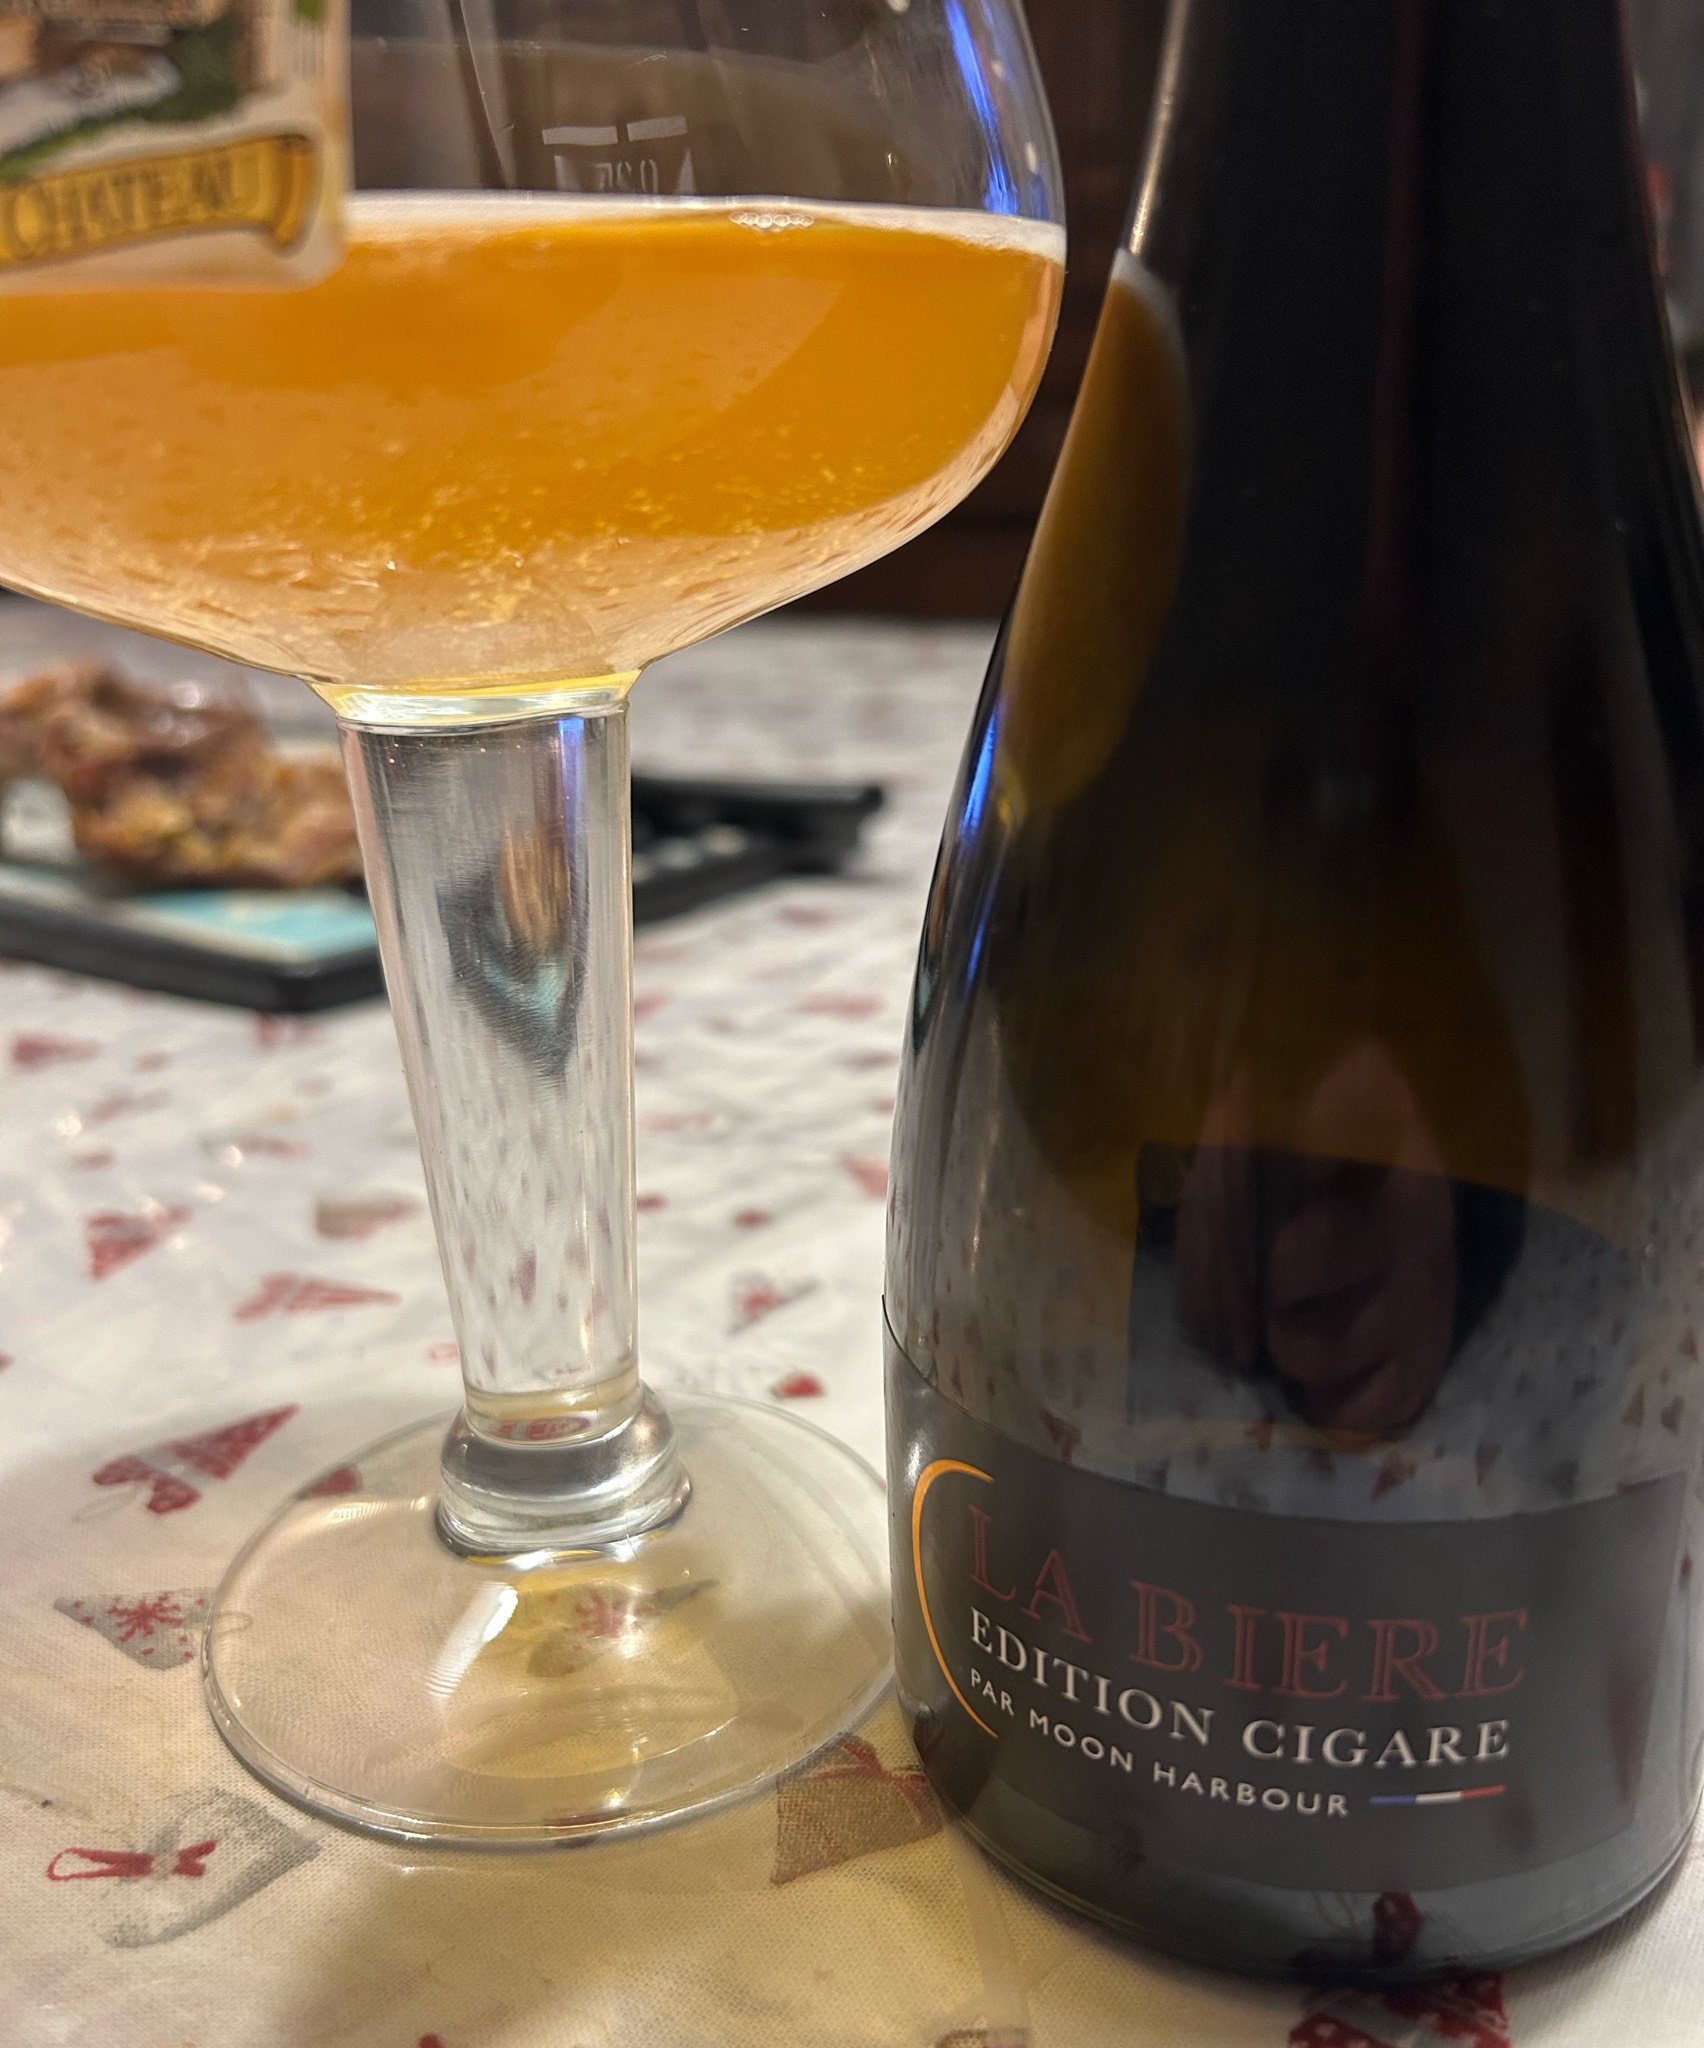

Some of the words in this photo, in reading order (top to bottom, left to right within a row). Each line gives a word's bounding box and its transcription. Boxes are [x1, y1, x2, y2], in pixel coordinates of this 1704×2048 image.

[969, 1503, 1096, 1644] LA
[1128, 1576, 1530, 1703] BIERE
[970, 1606, 1215, 1746] EDITION
[1241, 1719, 1512, 1769] CIGARE
[970, 1667, 1015, 1717] PAR
[1029, 1708, 1133, 1773] MOON
[1153, 1761, 1350, 1819] HARBOUR
